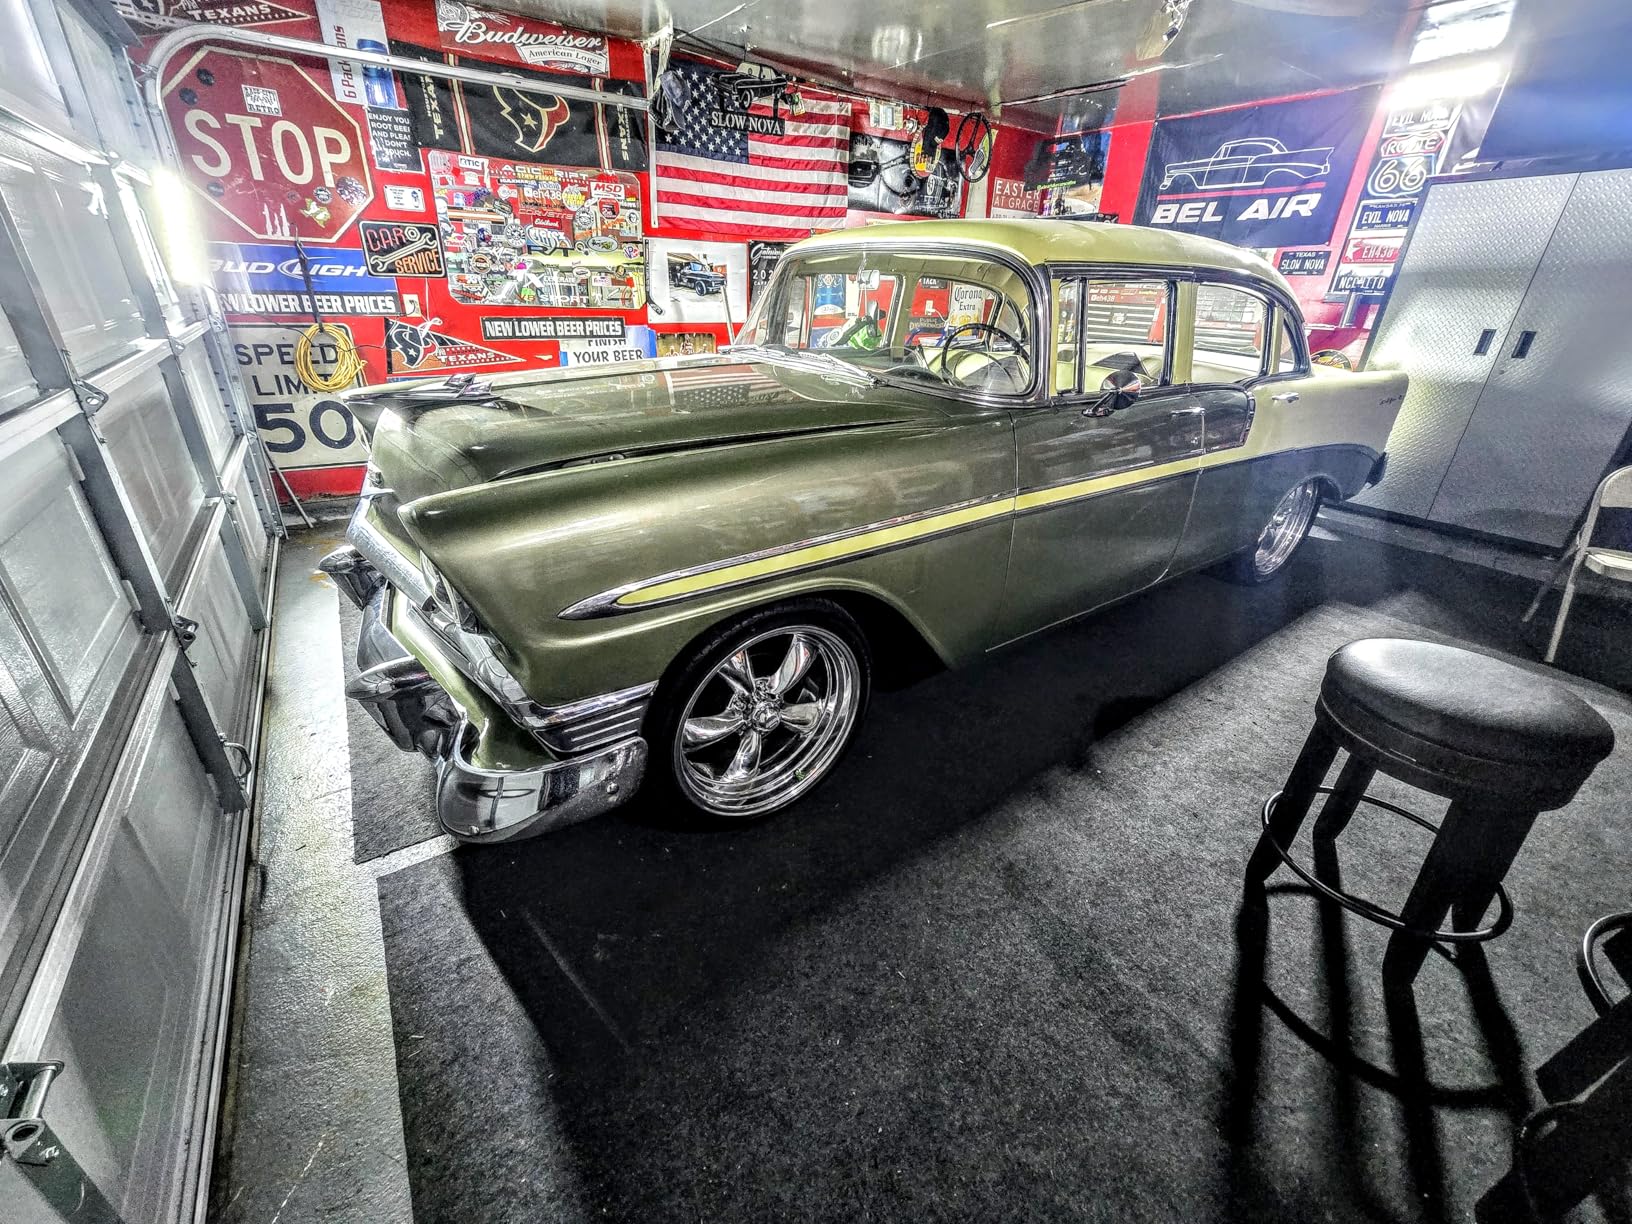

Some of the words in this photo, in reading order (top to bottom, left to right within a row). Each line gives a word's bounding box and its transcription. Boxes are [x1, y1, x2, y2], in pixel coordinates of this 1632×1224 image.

[187, 4, 271, 20] TEXANS
[454, 21, 603, 48] Budweiser
[529, 49, 573, 60] American
[575, 52, 602, 66] Lager
[343, 90, 357, 98] 6
[368, 112, 392, 121] ENJOY
[711, 112, 747, 129] SLOW
[748, 119, 781, 135] NOVA
[372, 130, 389, 138] AND
[184, 109, 351, 188] STOP
[1374, 157, 1426, 192] 66
[594, 184, 622, 193] MSD
[995, 180, 1040, 199] EASTER
[1008, 200, 1039, 210] GRACE
[1150, 201, 1223, 225] BEL
[1236, 192, 1322, 220] AIR
[1362, 211, 1382, 224] EVIL
[1386, 209, 1410, 222] NOVA
[366, 226, 405, 251] CAR
[290, 258, 367, 277] LIGH
[394, 249, 442, 274] SERVICE
[1281, 260, 1300, 270] SLOW
[1303, 259, 1325, 270] NOVA
[954, 287, 983, 301] Corona
[242, 294, 303, 313] LOWER
[303, 295, 342, 313] BEER
[344, 295, 396, 313] PRICES
[960, 302, 976, 311] Extra
[485, 320, 512, 337] NEW
[513, 319, 554, 336] LOWER
[556, 319, 584, 336] BEER
[586, 319, 622, 336] PRICES
[437, 352, 495, 362] TEXANS
[573, 351, 609, 364] YOUR
[614, 349, 643, 361] BEER
[253, 400, 356, 453] 50
